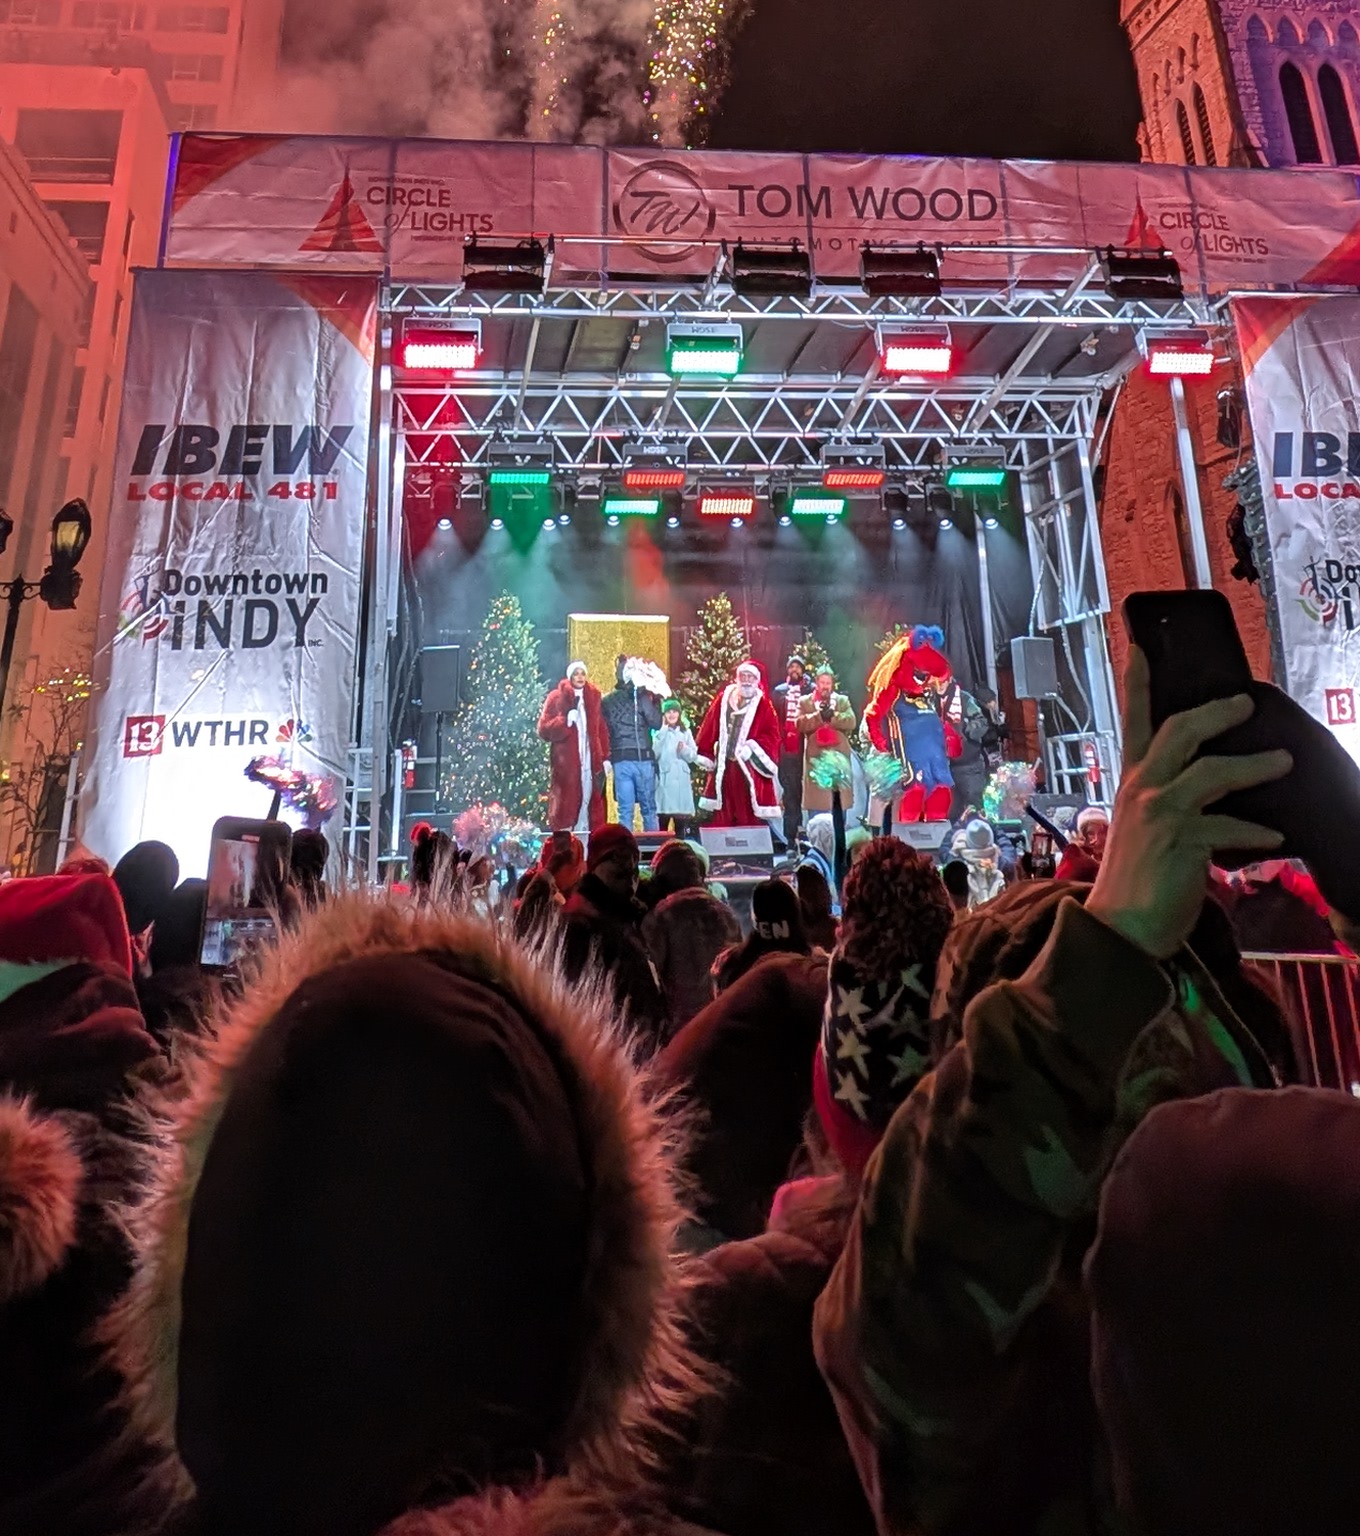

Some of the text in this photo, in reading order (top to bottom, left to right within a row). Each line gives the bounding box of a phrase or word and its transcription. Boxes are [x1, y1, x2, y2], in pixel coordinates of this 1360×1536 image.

[366, 185, 451, 208] CIRCLE
[727, 183, 998, 222] TOM WOOD
[411, 211, 494, 233] LIGHTS
[1160, 211, 1230, 232] CIRCLE
[1203, 233, 1269, 255] LIGHTS
[130, 424, 354, 476] IBEW
[127, 481, 338, 501] LOCAL 481
[164, 569, 328, 596] Downtown
[1330, 692, 1353, 721] 13
[128, 719, 269, 754] 13 WTHR
